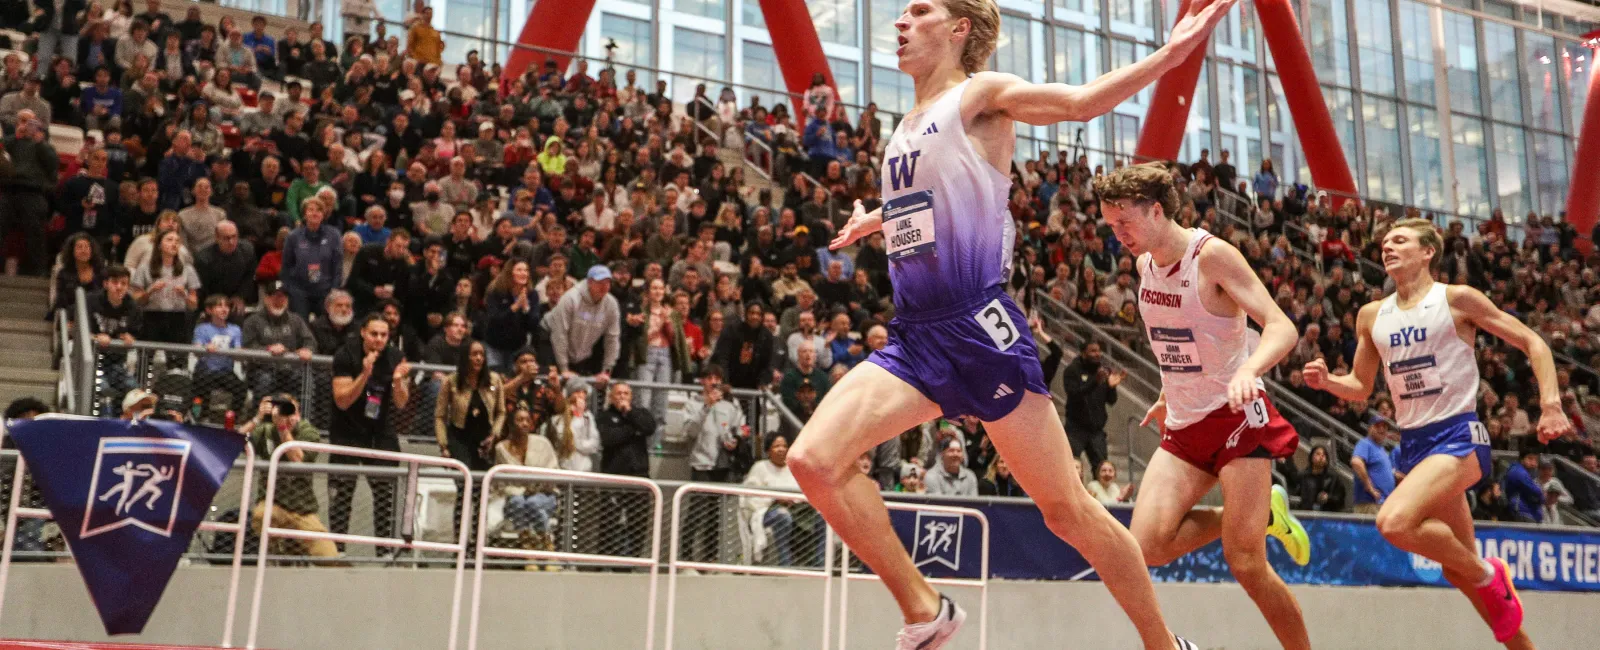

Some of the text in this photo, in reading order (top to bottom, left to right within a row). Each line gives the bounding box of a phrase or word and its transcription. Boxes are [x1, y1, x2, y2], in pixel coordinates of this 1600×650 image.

[888, 150, 921, 191] W
[896, 217, 912, 231] LUKE
[891, 229, 922, 248] HOUSER
[1140, 288, 1182, 309] WISCONSIN
[983, 307, 1014, 345] 3
[1390, 326, 1427, 348] BYU
[1161, 353, 1192, 364] SPENCER
[1403, 372, 1422, 382] LUCAS
[1253, 401, 1264, 423] 9
[1475, 424, 1488, 443] 10
[1538, 541, 1557, 582] &
[1560, 542, 1600, 583] FIE
